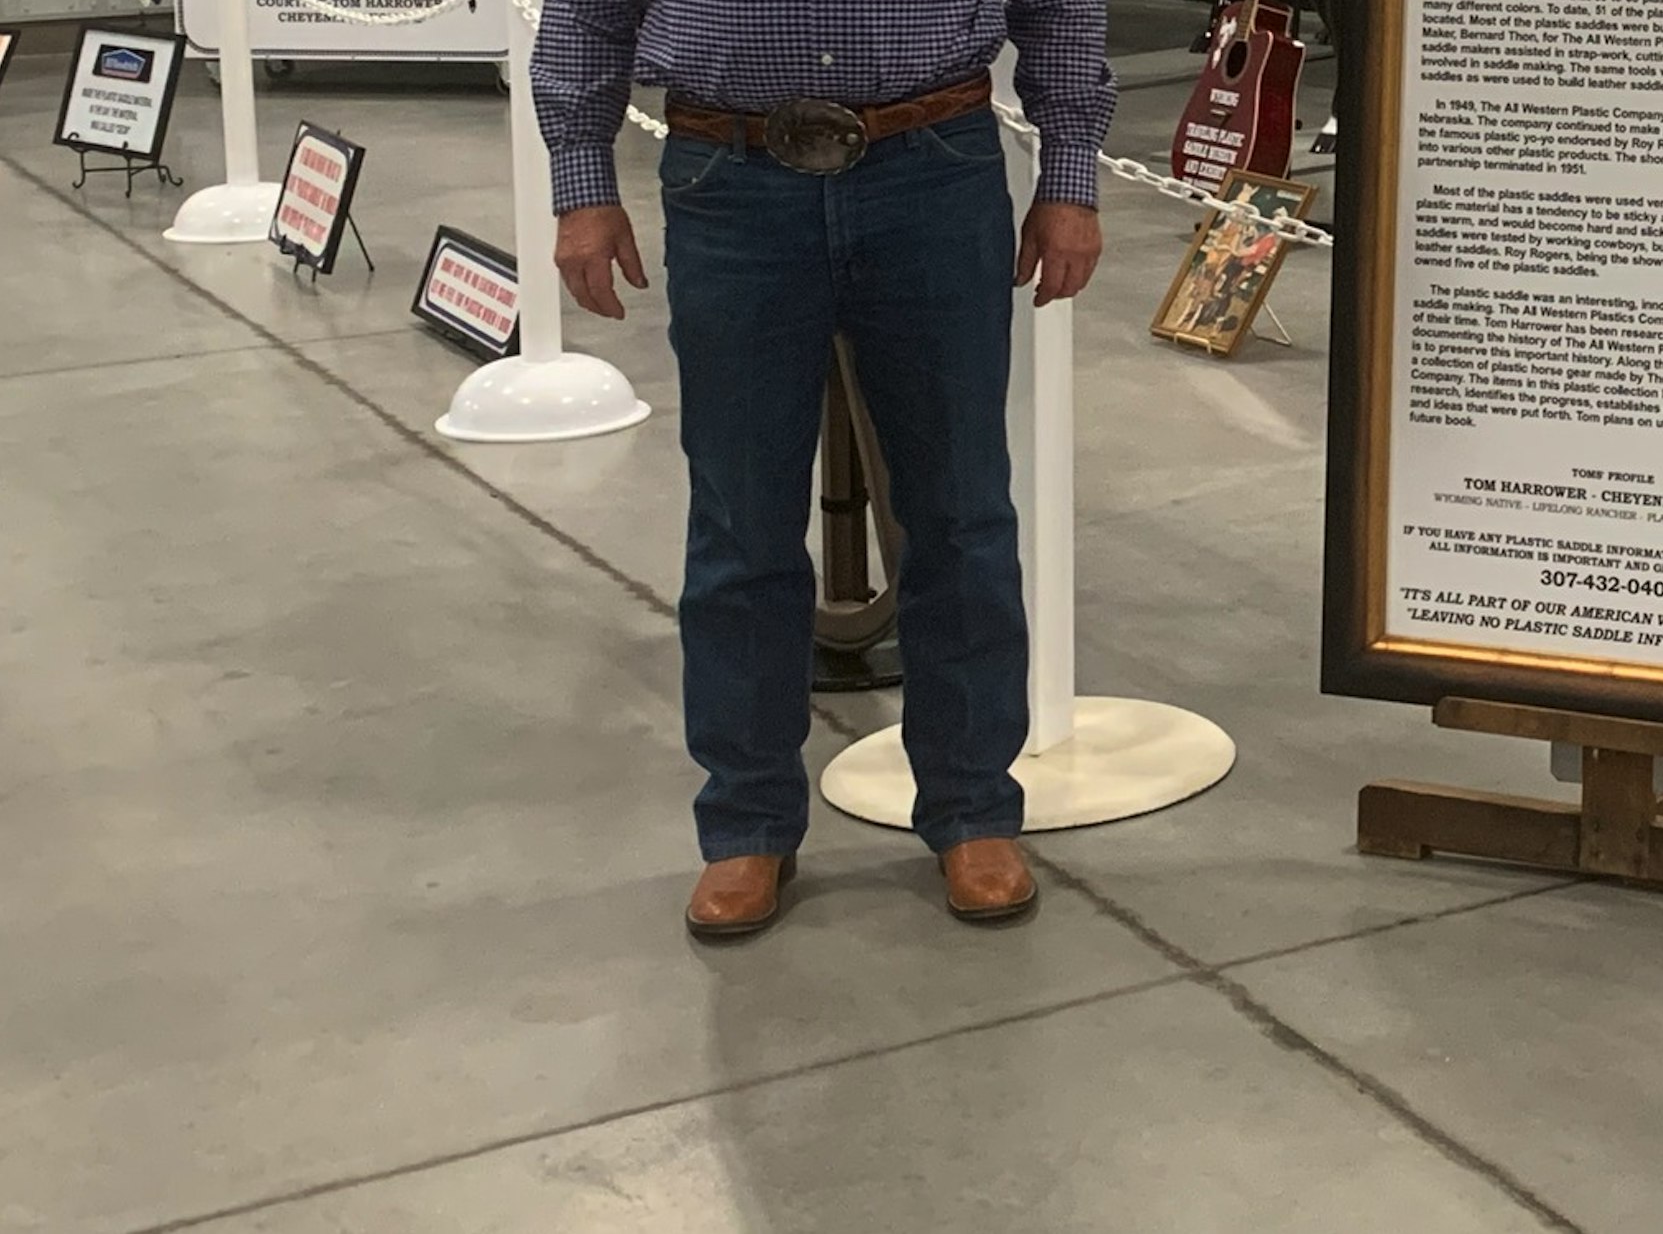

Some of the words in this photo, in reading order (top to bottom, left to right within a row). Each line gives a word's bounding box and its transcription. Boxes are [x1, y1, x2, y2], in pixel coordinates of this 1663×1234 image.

[1434, 98, 1447, 110] In
[1448, 99, 1477, 113] 1949,
[1479, 99, 1502, 113] The
[1503, 101, 1519, 114] All
[1521, 102, 1569, 116] Western
[1571, 104, 1610, 119] Plastic
[1416, 156, 1482, 171] partnership
[1482, 159, 1544, 173] terminated
[1545, 161, 1557, 173] in
[1559, 162, 1586, 175] 1951.
[1408, 410, 1443, 425] future
[1444, 413, 1476, 427] book.
[1463, 476, 1497, 492] TOM
[1500, 480, 1588, 501] HARROWER
[1607, 470, 1655, 485] PROFILE
[1433, 492, 1483, 507] WYOMING
[1484, 496, 1523, 510] NATIVE
[1531, 501, 1583, 516] LIFELONG
[1585, 506, 1638, 521] RANCHER
[1402, 524, 1416, 535] IF
[1417, 525, 1442, 538] YOU
[1443, 528, 1476, 541] HAVE
[1477, 531, 1503, 544] ANY
[1504, 533, 1554, 549] PLASTIC
[1556, 539, 1604, 554] SADDLE
[1428, 540, 1451, 552] ALL
[1453, 542, 1535, 560] INFORMATION
[1536, 550, 1550, 562] IS
[1551, 552, 1622, 569] IMPORTANT
[1623, 559, 1651, 572] AND
[1434, 590, 1464, 606] ALL
[1466, 593, 1508, 610] PART
[1510, 598, 1532, 612] OF
[1533, 600, 1567, 616] OUR
[1569, 604, 1654, 625] AMERICAN
[1406, 607, 1475, 627] "LEAVING
[1478, 614, 1501, 629] NO
[1503, 617, 1569, 637] PLASTIC
[1571, 624, 1634, 644] SADDLE
